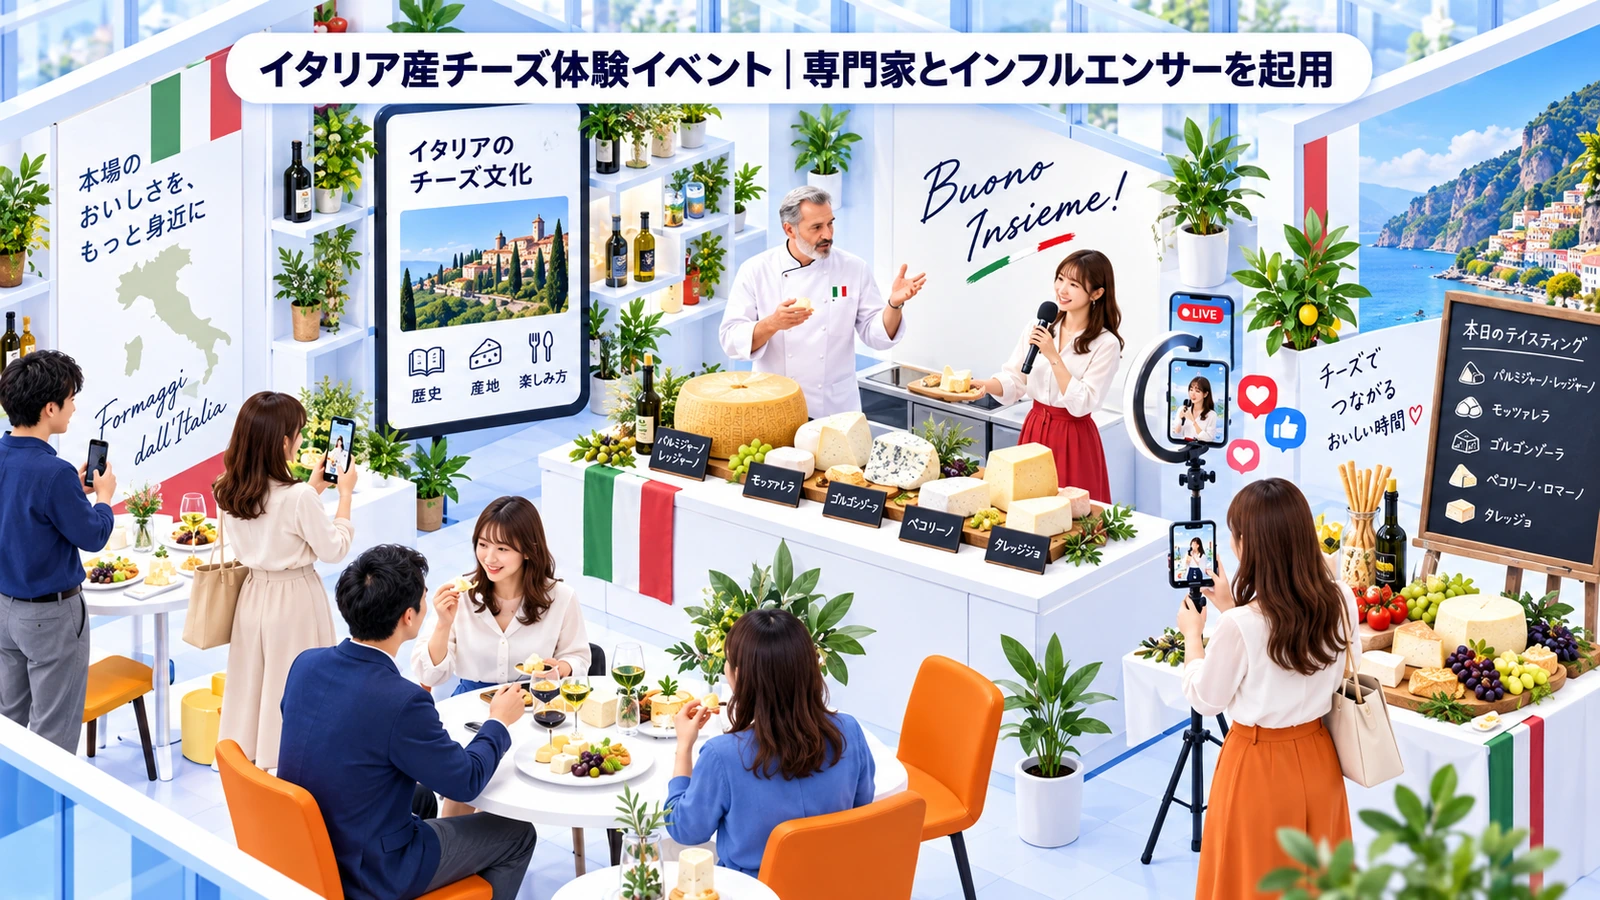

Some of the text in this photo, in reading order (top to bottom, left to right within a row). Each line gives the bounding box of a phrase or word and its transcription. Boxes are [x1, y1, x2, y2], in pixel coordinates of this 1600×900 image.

[409, 136, 513, 162] イタリアの
[79, 154, 140, 192] 本場の
[411, 163, 532, 193] チーズ文化
[81, 173, 193, 228] おいしさを、
[921, 159, 1054, 224] Buono
[82, 200, 205, 262] もっと身近に
[967, 171, 1127, 262] Insieme!
[1192, 308, 1217, 320] LIVE
[1463, 319, 1587, 353] 本日のテイスティング
[520, 370, 567, 388] 楽しみ方
[1320, 347, 1382, 389] チーズで
[412, 387, 442, 403] 歴史
[471, 379, 500, 395] 産地
[1332, 380, 1395, 415] つながる
[95, 369, 187, 440] Formaggi
[1492, 404, 1549, 422] モッツァレラ
[135, 398, 227, 465] dall'Italia
[1328, 410, 1405, 451] おいしい時間
[1490, 438, 1564, 460] ゴルゴンゾーラ
[1485, 508, 1531, 527] タレッジョ
